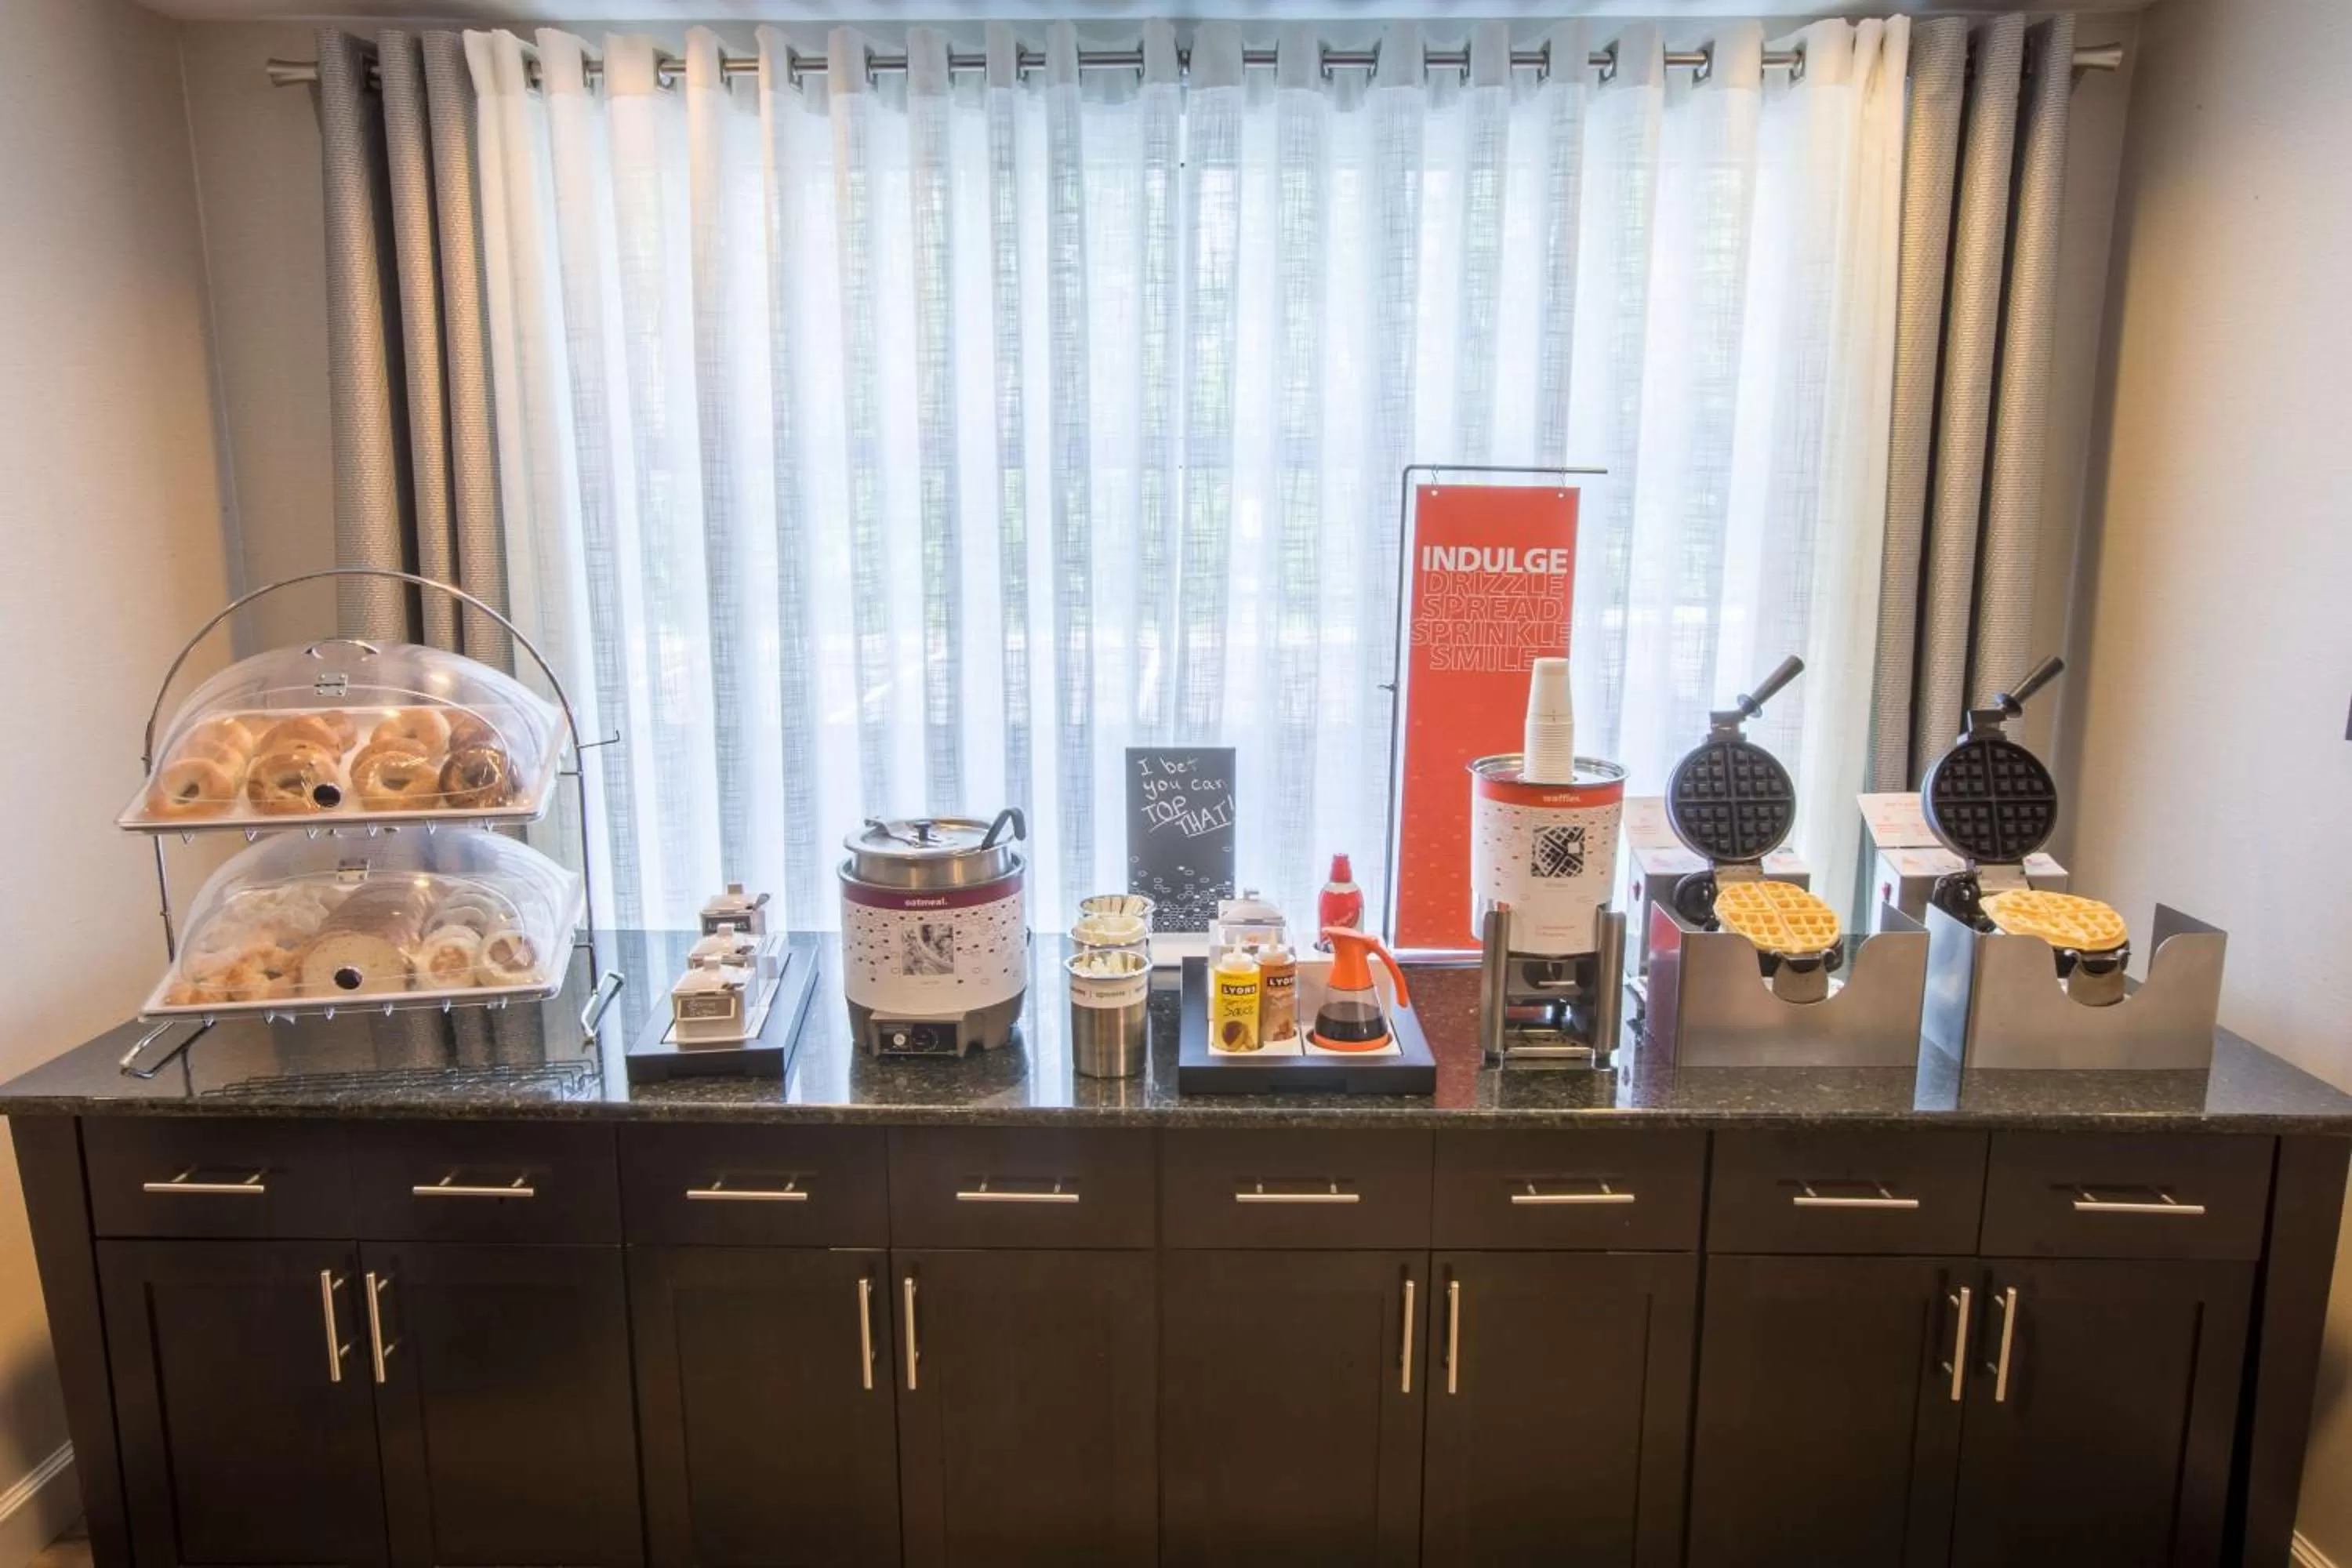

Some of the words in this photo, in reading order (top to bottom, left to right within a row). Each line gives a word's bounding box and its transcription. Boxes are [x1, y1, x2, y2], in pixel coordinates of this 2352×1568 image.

[1421, 545, 1568, 574] INDULGE
[1422, 570, 1565, 599] DRIZZLE
[1421, 595, 1565, 622] SPREAD
[1410, 619, 1572, 648] SPRINKLE
[1429, 644, 1539, 672] SMILE
[1138, 757, 1154, 775] I
[1160, 756, 1199, 775] bet
[1142, 779, 1182, 800] you
[1190, 778, 1226, 792] can
[1142, 795, 1187, 824] TOP
[1176, 794, 1236, 836] THAT!
